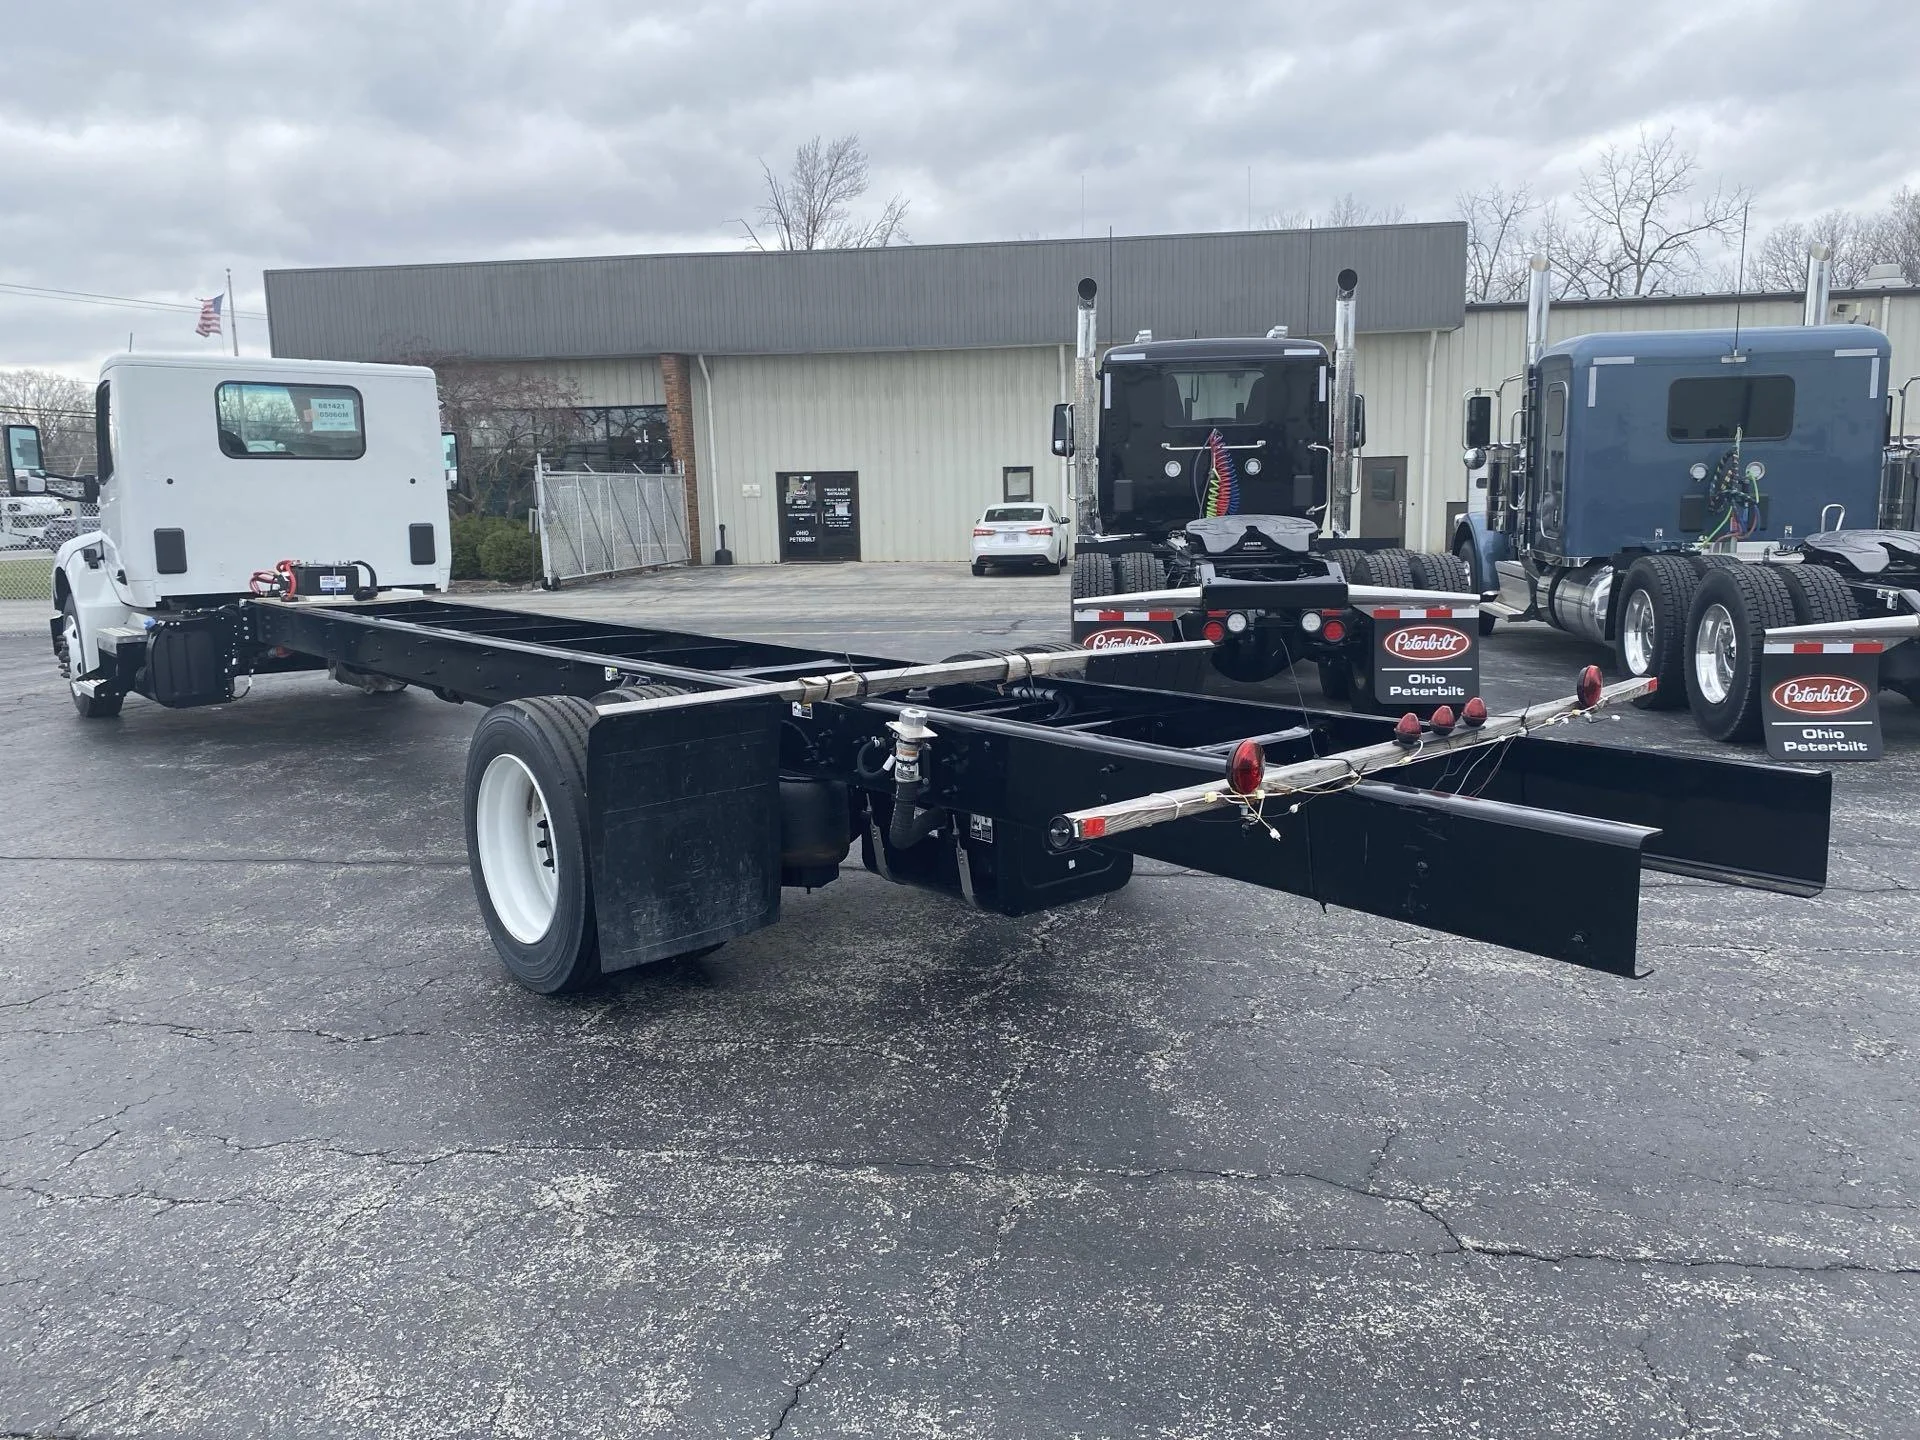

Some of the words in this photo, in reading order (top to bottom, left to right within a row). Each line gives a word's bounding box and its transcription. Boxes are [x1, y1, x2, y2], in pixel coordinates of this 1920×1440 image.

[1394, 632, 1463, 652] Peterbilt
[1408, 674, 1446, 684] Ohio
[1389, 686, 1465, 696] Peterbilt
[1783, 683, 1860, 704] Peterbilt
[1802, 728, 1845, 739] Ohio
[1783, 741, 1868, 752] Peterbilt
